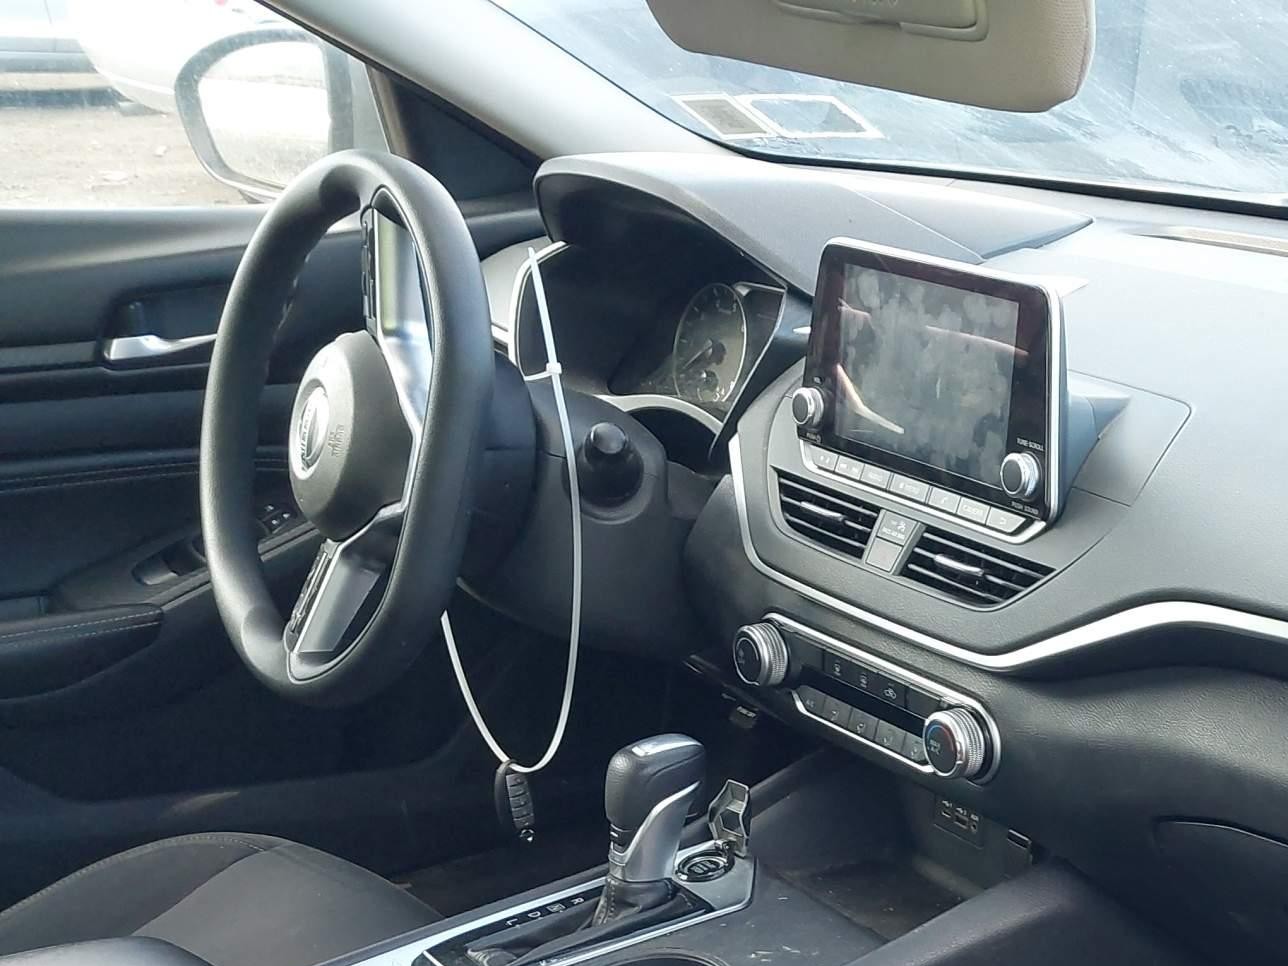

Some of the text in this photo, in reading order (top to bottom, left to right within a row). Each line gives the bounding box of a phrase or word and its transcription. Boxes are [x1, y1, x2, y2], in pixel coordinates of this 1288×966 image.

[571, 897, 585, 905] R
[527, 910, 542, 918] D
[505, 918, 518, 926] L
